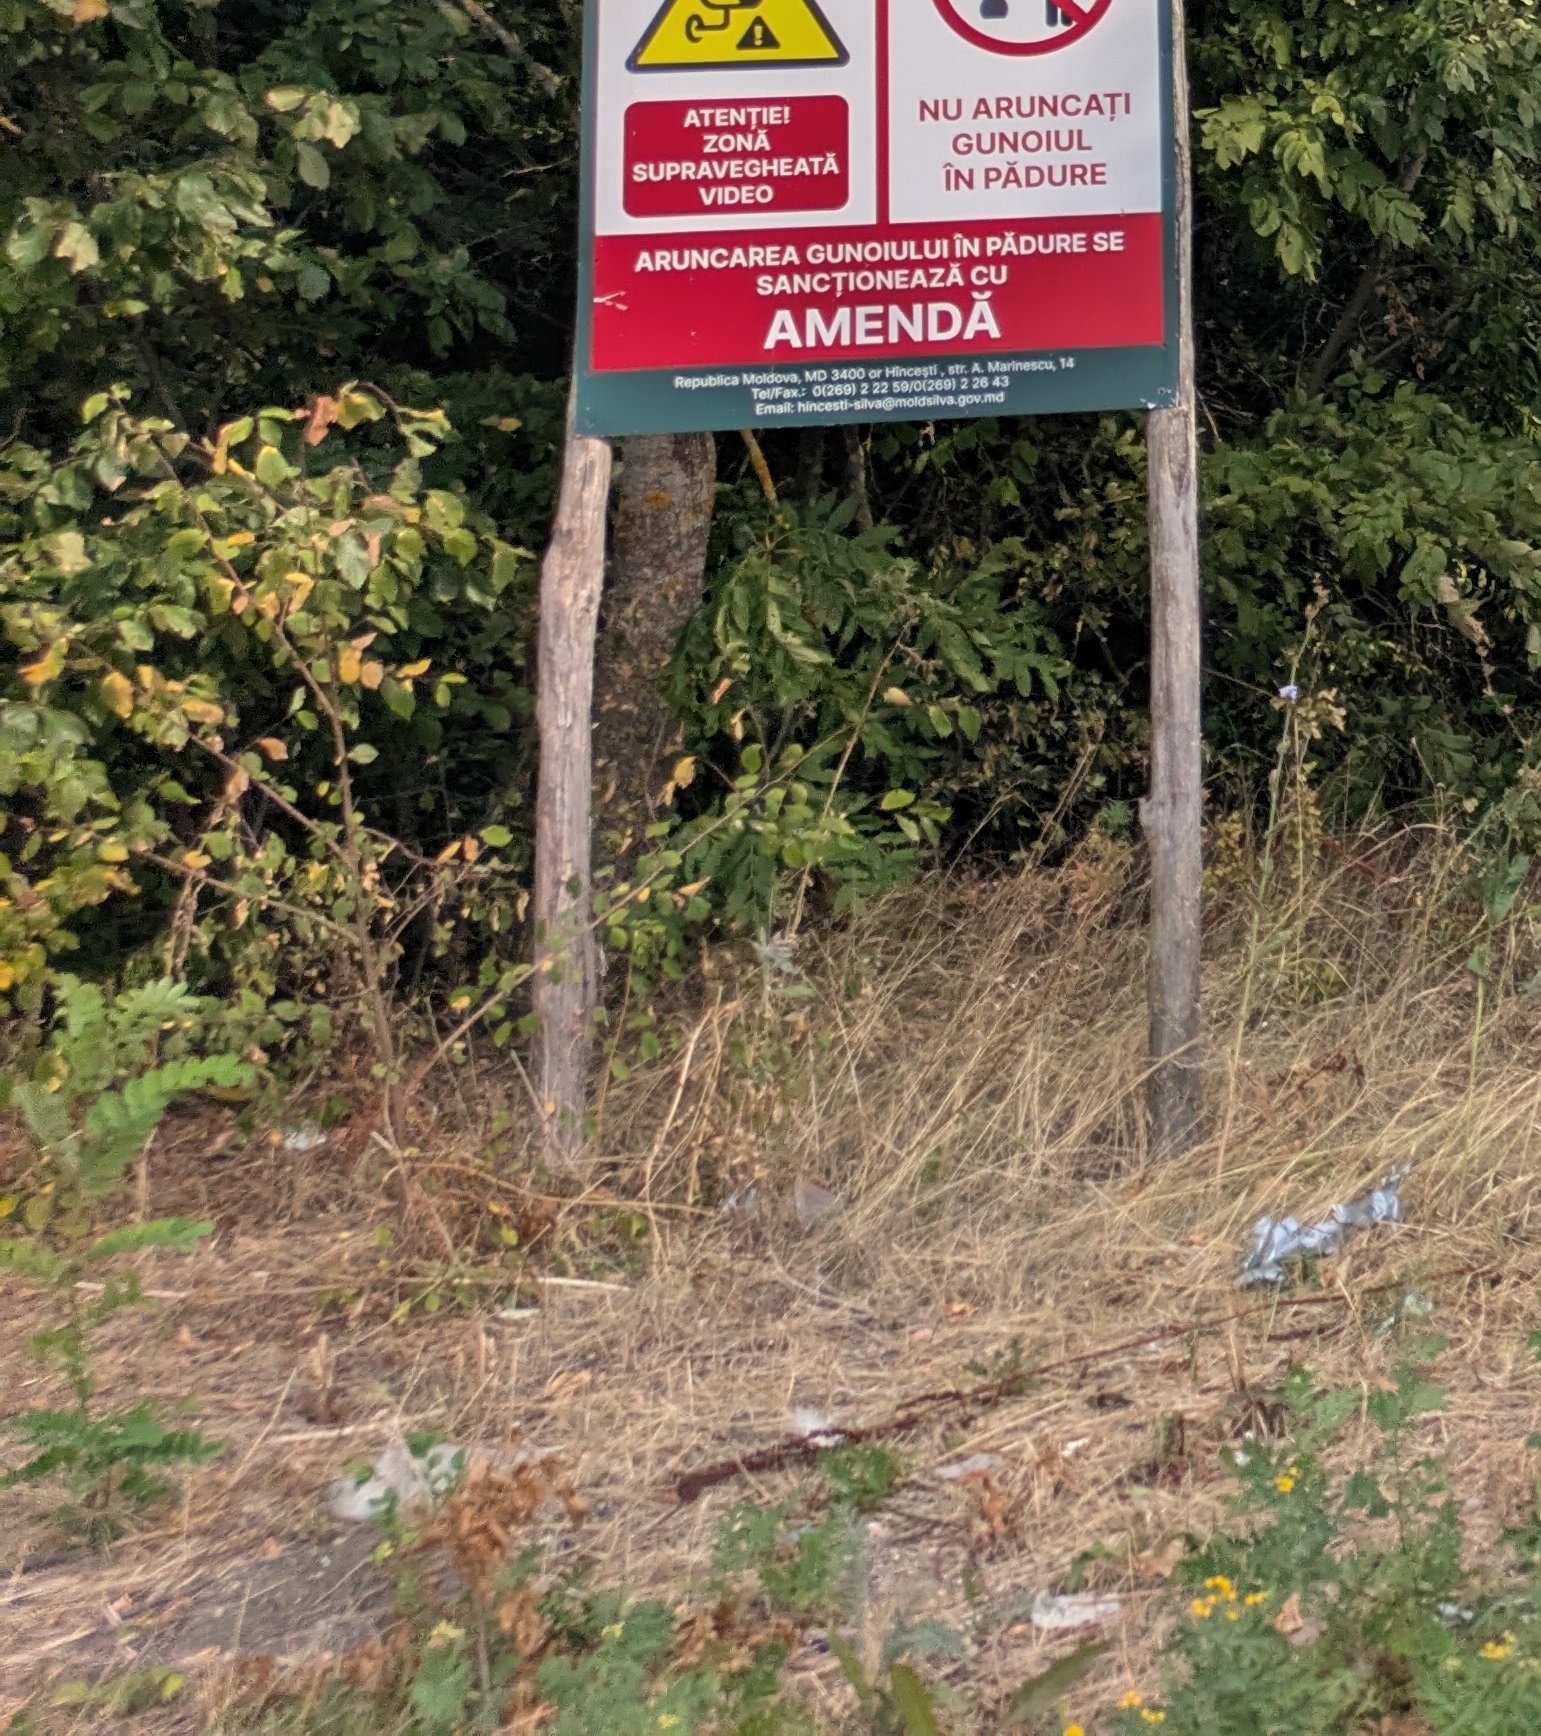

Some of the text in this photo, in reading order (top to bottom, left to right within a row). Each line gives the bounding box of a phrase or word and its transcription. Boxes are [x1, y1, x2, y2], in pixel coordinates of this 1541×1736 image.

[683, 106, 791, 130] ATENȚIE!
[919, 92, 1131, 122] NU ARUNCAȚI
[703, 129, 771, 153] ZONĂ
[951, 129, 1093, 155] GUNOIUL
[632, 152, 840, 182] SUPRAVEGHEATĂ
[942, 161, 1107, 191] ÎN PĂDURE
[699, 185, 774, 206] VIDEO
[634, 231, 1125, 273] ARUNCAREA GUNOIULUI ÎN PĂDURE SE
[756, 262, 1008, 298] SANCȚIONEAZĂ CU
[763, 290, 1002, 350] AMENDĂ
[674, 375, 739, 390] Republica
[742, 372, 801, 385] Moldova,
[805, 369, 828, 382] MD
[831, 368, 865, 381] 3400
[868, 369, 882, 380] or
[948, 365, 968, 376] str.
[971, 363, 984, 374] A.
[988, 359, 1056, 373] Marinescu,
[1059, 357, 1075, 369] 14
[812, 383, 857, 398] 0(269)
[872, 383, 889, 394] 22
[892, 378, 955, 394] 59/0(269)
[972, 377, 989, 388] 26
[992, 375, 1010, 388] 43
[755, 401, 794, 415] Email:
